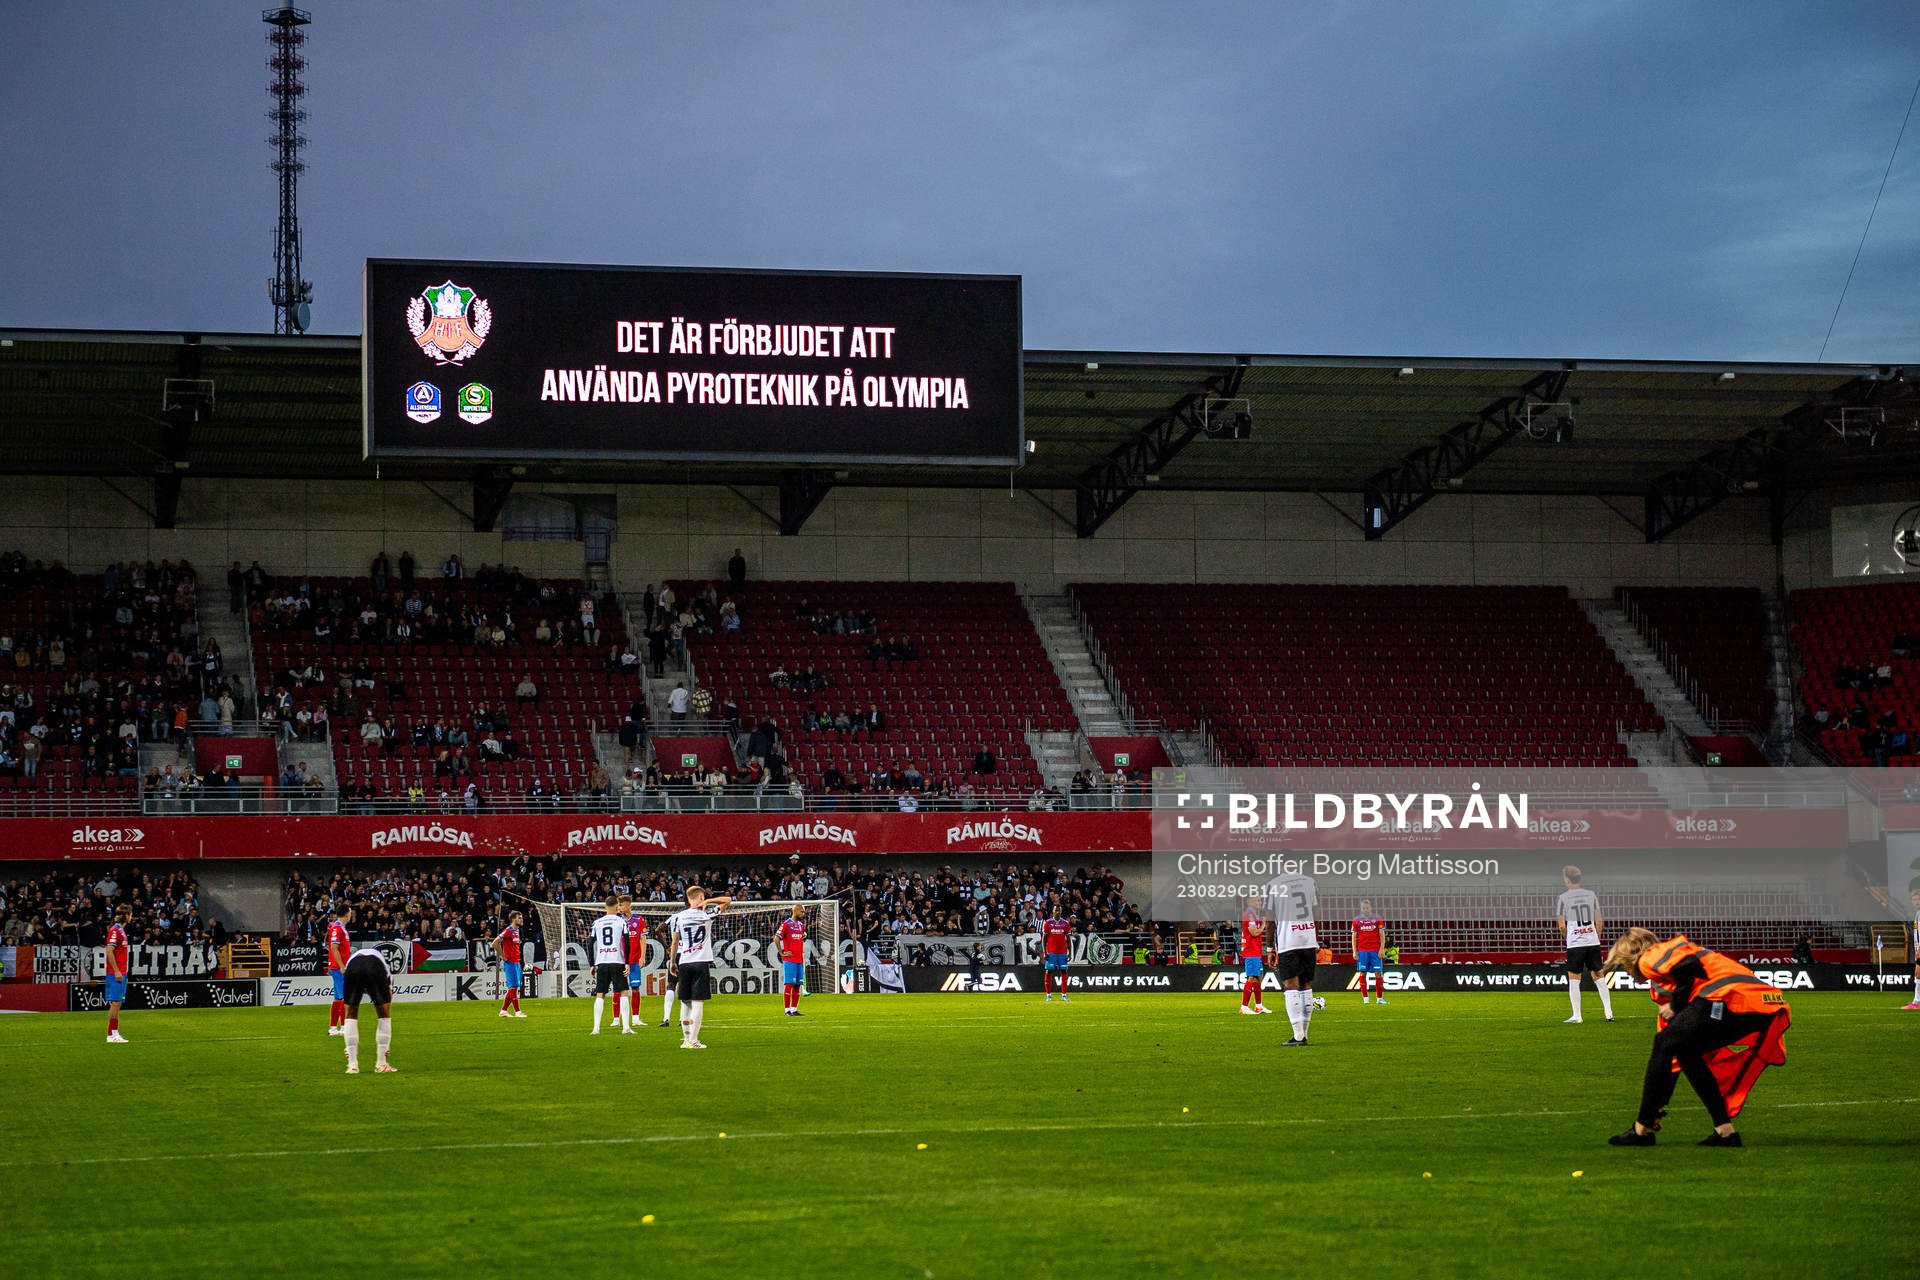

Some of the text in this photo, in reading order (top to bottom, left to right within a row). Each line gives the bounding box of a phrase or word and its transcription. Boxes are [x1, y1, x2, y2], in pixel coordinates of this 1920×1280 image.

[616, 317, 896, 358] DET ÄR FÖRBJUDET ATT
[541, 365, 969, 408] ANVÄNDA PYROTEKNIK PÅ OLYMPIA
[947, 818, 1042, 846] RAMLÖSA
[1529, 817, 1571, 833] akea
[1676, 816, 1718, 832] akea
[72, 825, 122, 843] akea
[372, 822, 473, 850] RAMLÖSA
[568, 821, 667, 848] RAMLÖSA
[760, 820, 857, 847] RAMLÖSA
[1291, 892, 1309, 919] 3
[1570, 904, 1592, 927] 10
[1291, 923, 1315, 931] PULS
[602, 926, 613, 946] 8
[683, 925, 706, 948] 14
[36, 945, 79, 959] IBBE'S
[276, 948, 290, 957] NO
[36, 958, 78, 973] IBBE'S
[277, 961, 317, 972] NO PARTY
[1087, 976, 1120, 986] VENT
[1123, 976, 1133, 986] &
[1136, 976, 1170, 986] KYLA
[1456, 975, 1568, 987] VVS, VENT & KYLA
[1845, 974, 1911, 986] VVS, VENT
[150, 990, 188, 1005] Valvet
[216, 988, 254, 1004] Valvet
[292, 988, 334, 997] BOLAGE
[392, 985, 433, 994] OLAGET
[84, 991, 111, 1007] Valv
